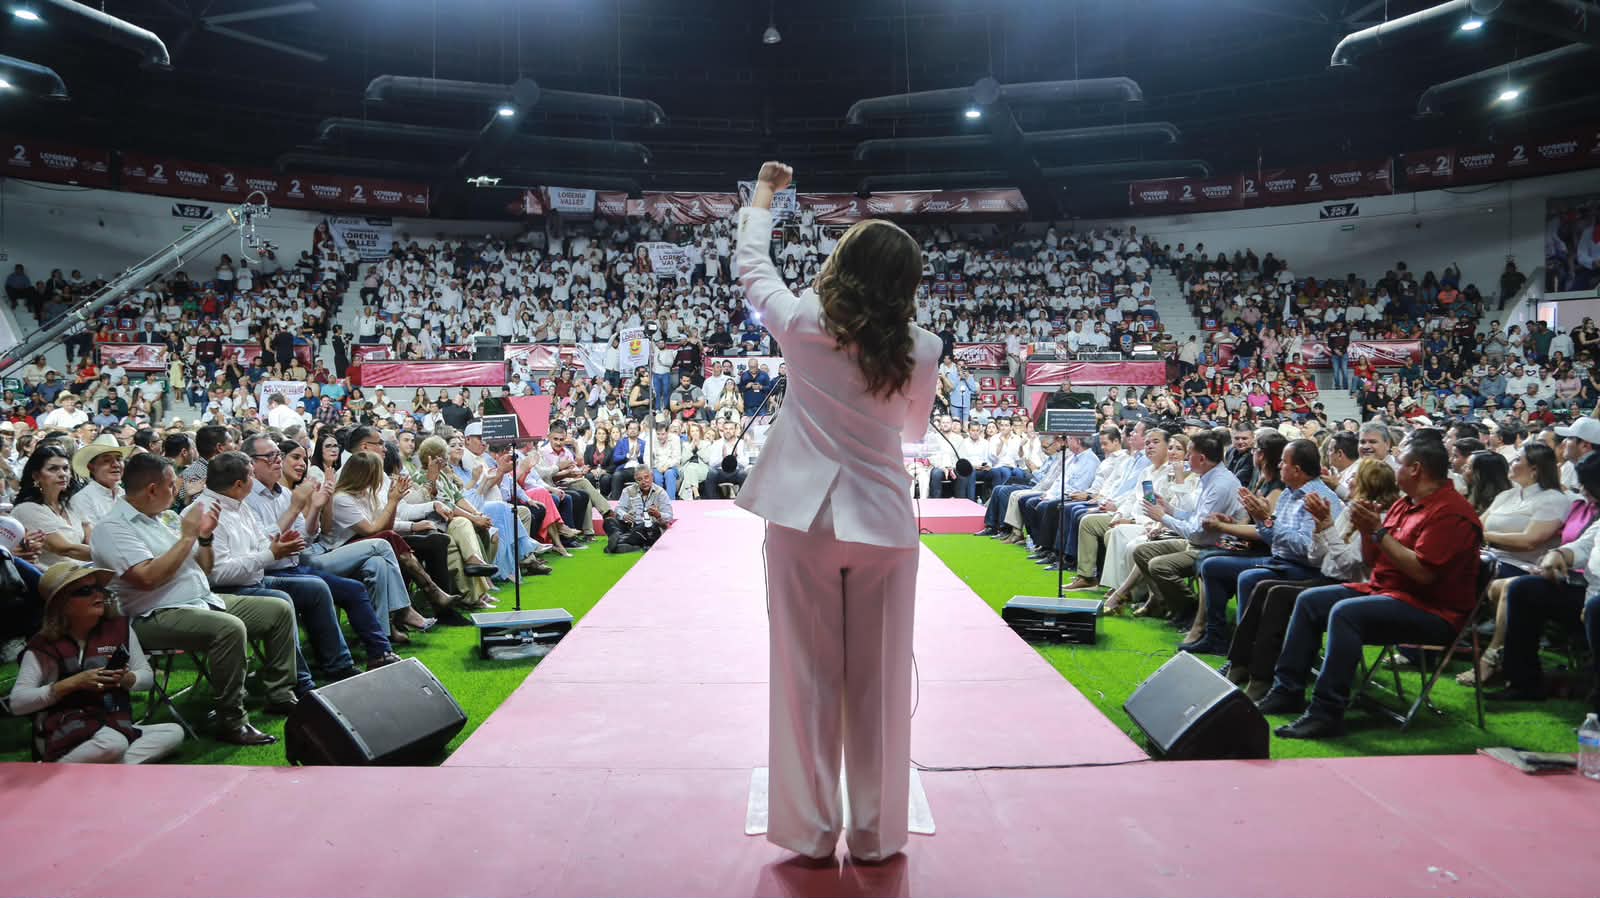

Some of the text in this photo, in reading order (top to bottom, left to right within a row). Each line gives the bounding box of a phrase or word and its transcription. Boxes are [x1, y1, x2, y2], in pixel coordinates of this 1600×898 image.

[14, 145, 25, 160] 2
[1513, 145, 1524, 160] 2
[1436, 156, 1449, 170] 2
[153, 164, 163, 178] 2
[224, 173, 234, 187] 2
[1309, 173, 1319, 186] 2
[291, 180, 301, 193] 2
[354, 185, 363, 198] 2
[1183, 185, 1193, 198] 2
[1246, 180, 1255, 193] 2
[558, 192, 586, 200] LORENIA
[560, 198, 584, 206] VALLES
[691, 200, 700, 211] 2
[849, 201, 858, 212] 2
[960, 197, 969, 209] 2
[342, 231, 379, 241] LORENIA
[235, 347, 246, 362] 2
